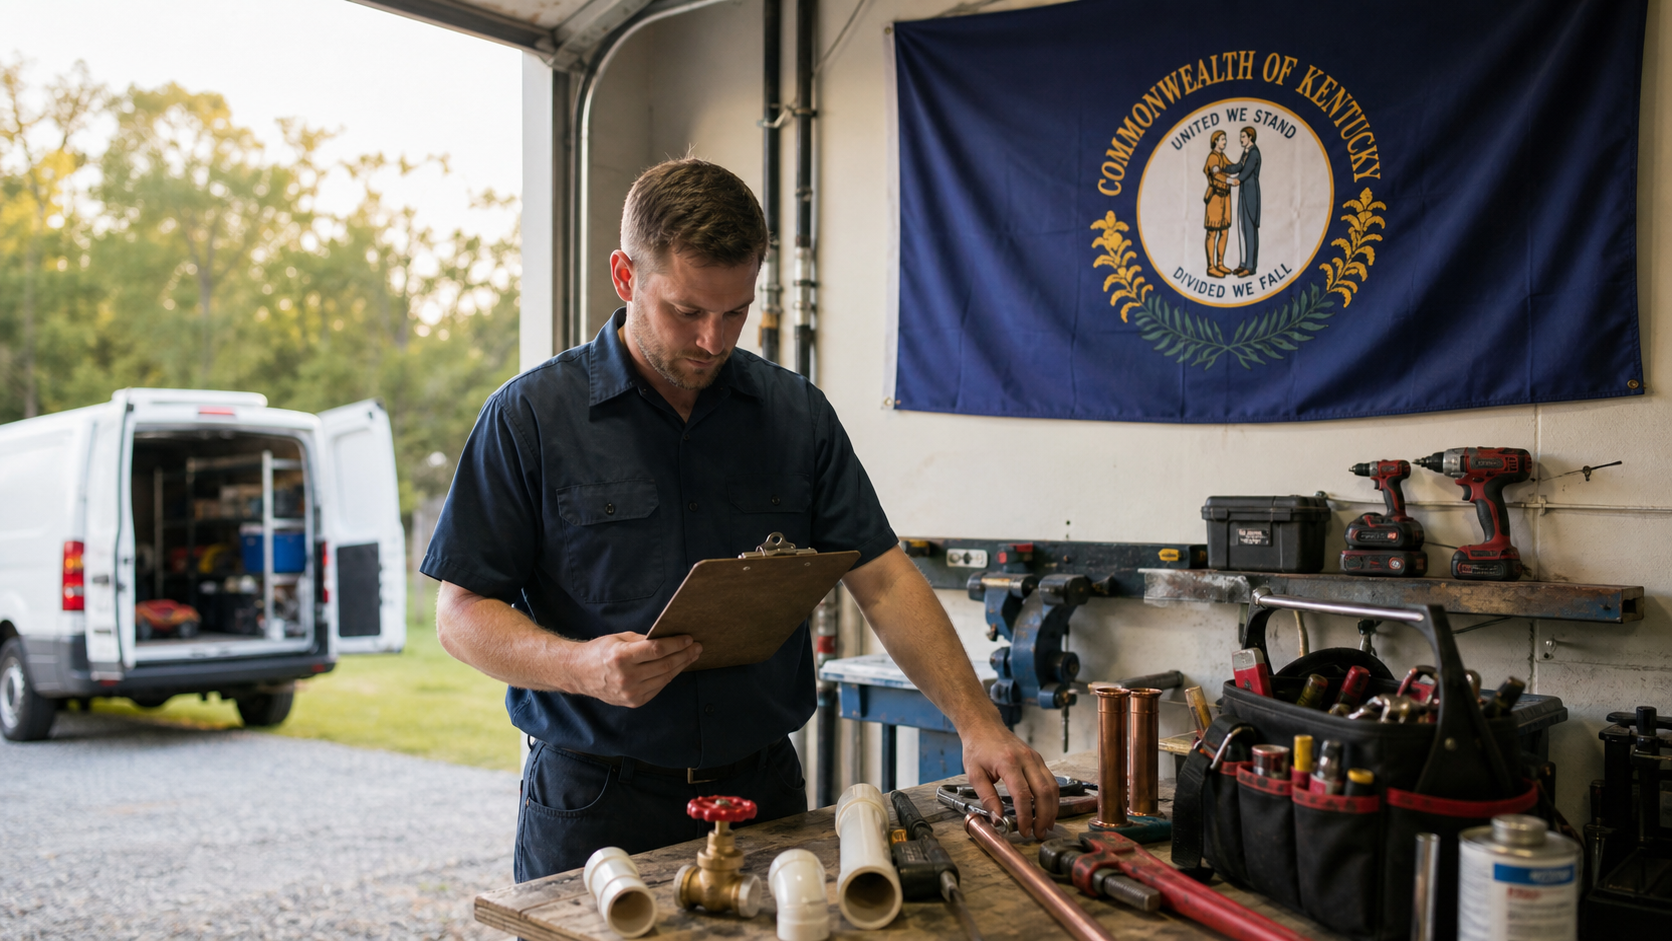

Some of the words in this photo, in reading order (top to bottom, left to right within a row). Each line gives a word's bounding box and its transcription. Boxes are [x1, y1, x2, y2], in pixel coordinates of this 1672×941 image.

[1097, 50, 1256, 196] COMMONWEALTH
[1262, 52, 1298, 86] OF
[1295, 64, 1381, 183] KENTUCKY
[1170, 112, 1220, 151] UNITED
[1226, 107, 1248, 122] WE
[1253, 109, 1297, 139] STAND
[1172, 266, 1226, 298] DIVIDED
[1232, 281, 1254, 298] WE
[1259, 263, 1292, 290] FALL
